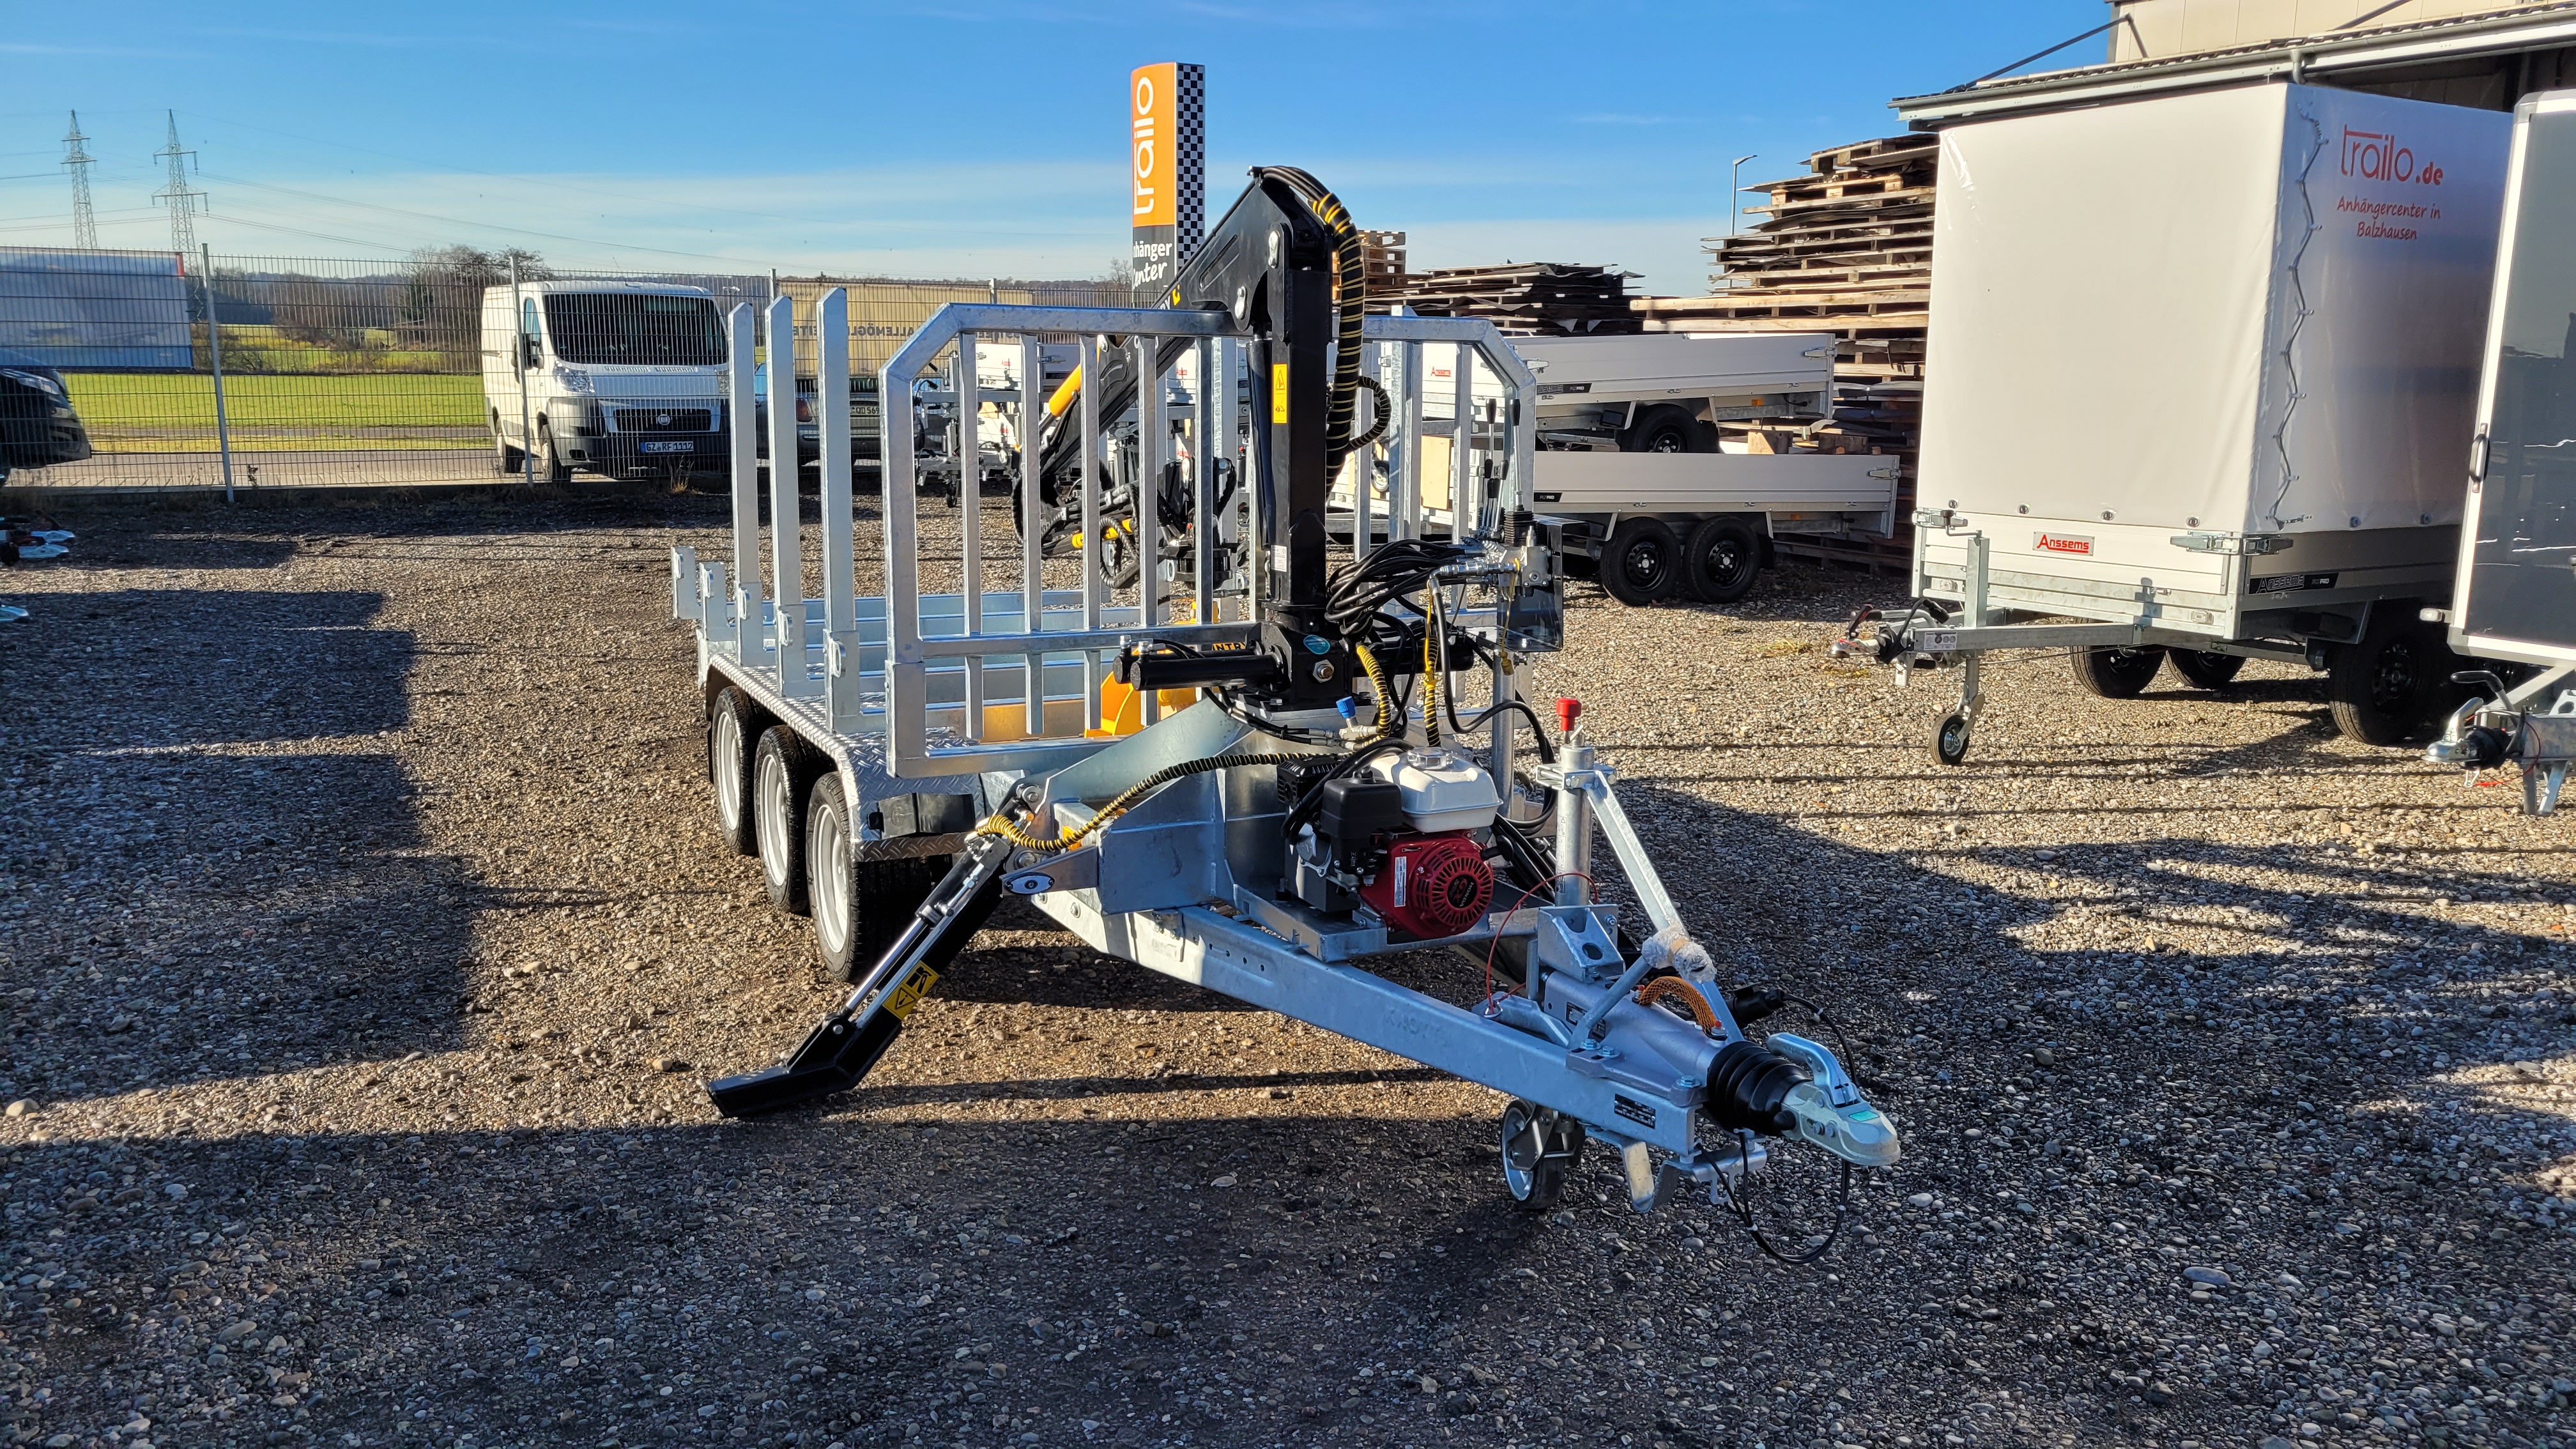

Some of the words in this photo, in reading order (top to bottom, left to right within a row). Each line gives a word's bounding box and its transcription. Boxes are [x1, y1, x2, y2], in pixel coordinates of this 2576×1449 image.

[1133, 76, 1154, 215] trailo
[2341, 124, 2444, 185] trailo.de
[2337, 195, 2427, 220] Anhängercenter
[2430, 203, 2441, 219] in
[2356, 220, 2418, 240] Balzhausen
[646, 443, 656, 451] GZ
[662, 442, 672, 451] RF
[2036, 533, 2090, 554] Anssems
[2255, 575, 2305, 594] Anssems
[1459, 882, 1475, 907] HONDA
